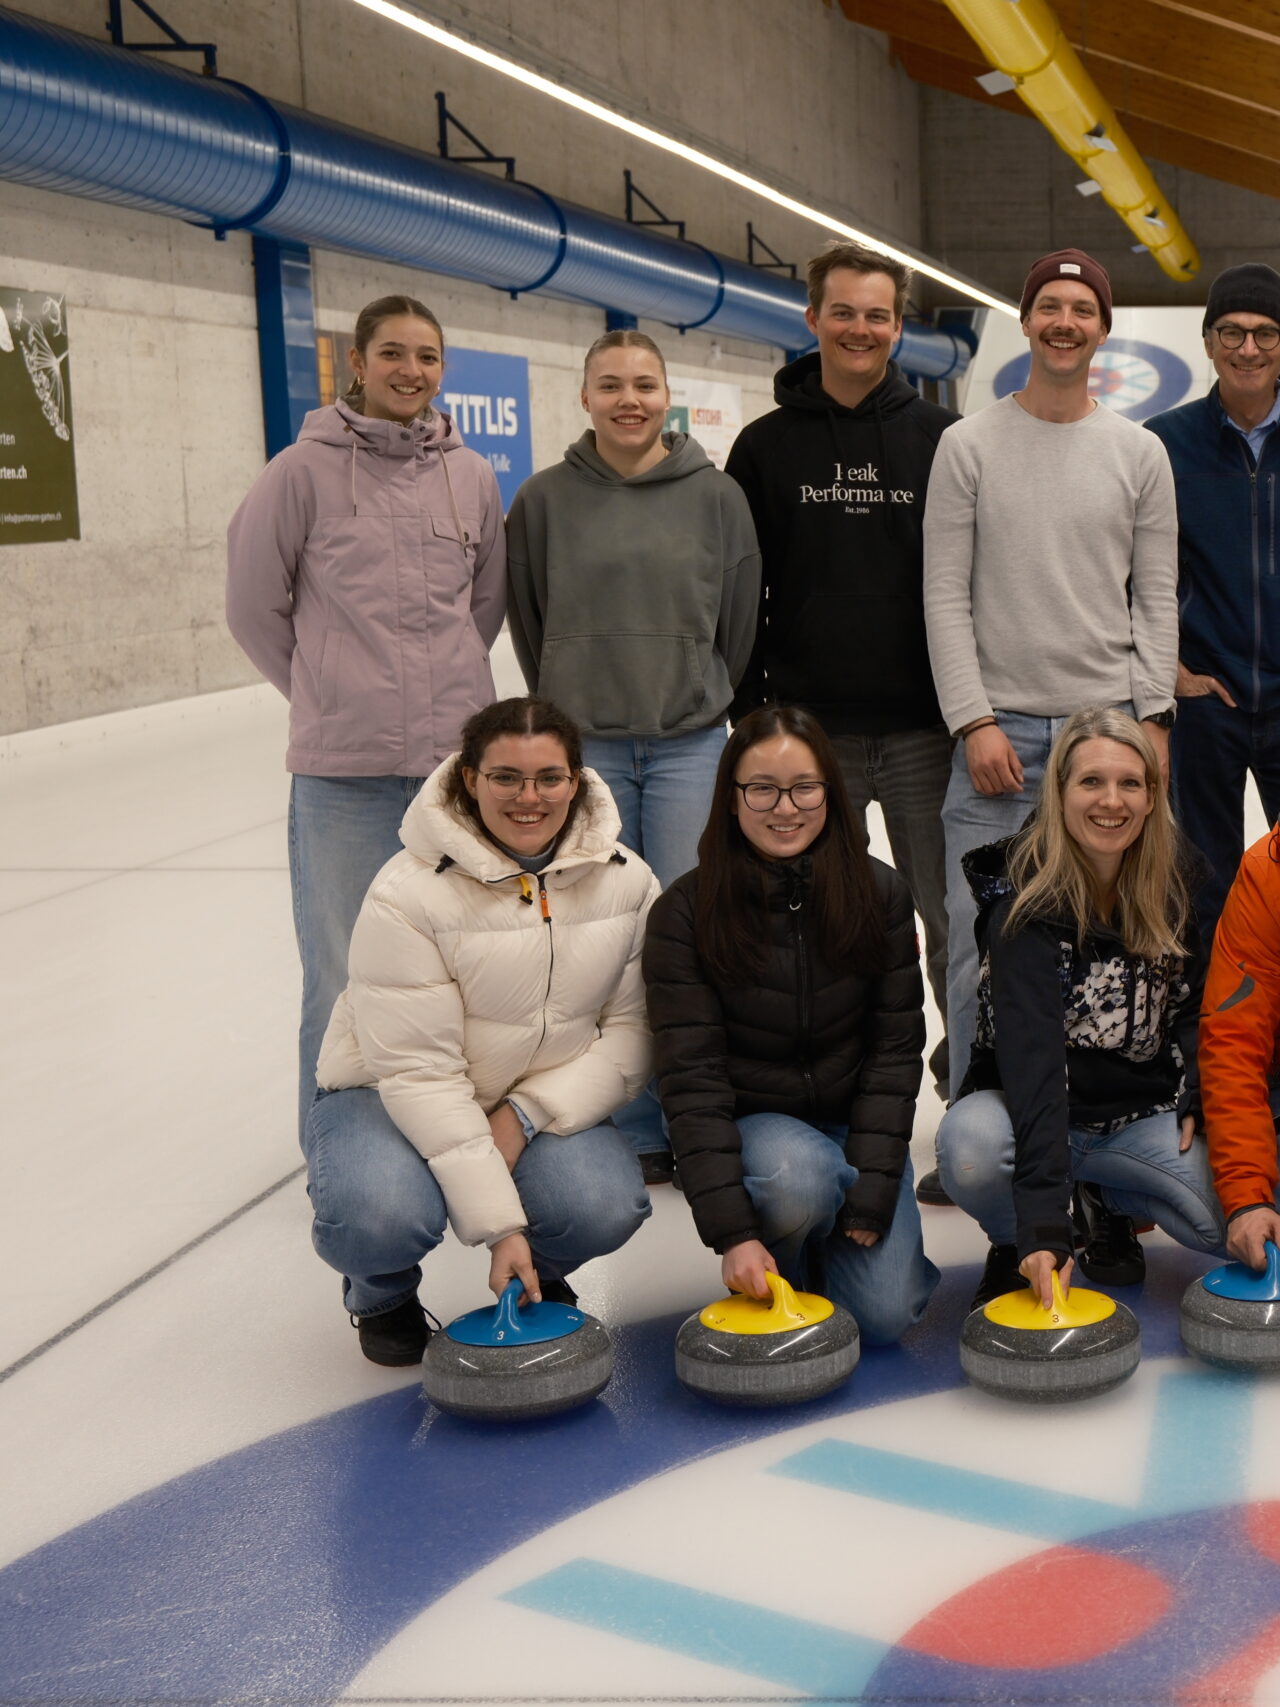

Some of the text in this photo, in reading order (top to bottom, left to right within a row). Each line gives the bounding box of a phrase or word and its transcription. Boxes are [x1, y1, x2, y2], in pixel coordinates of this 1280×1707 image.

[444, 393, 518, 437] TITLIS
[797, 1312, 806, 1321] 3
[1053, 1314, 1060, 1323] 3
[497, 1330, 504, 1340] 3
